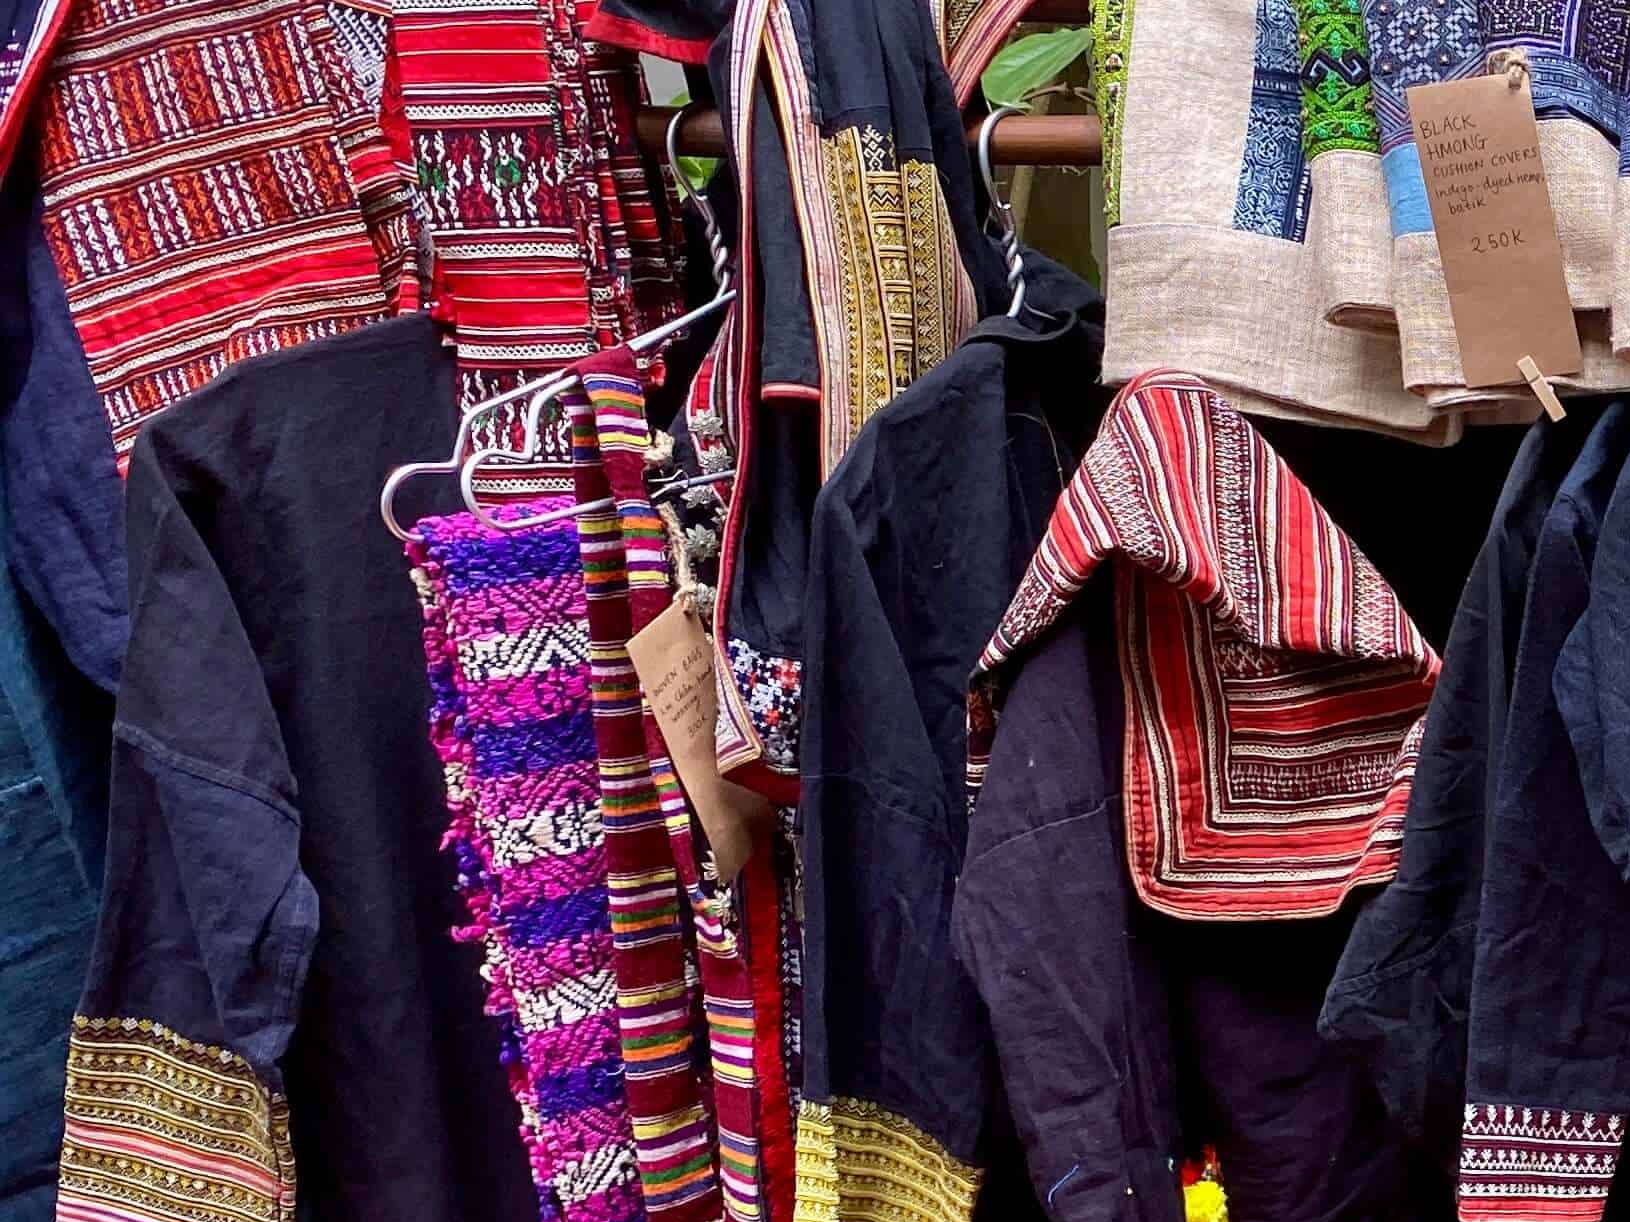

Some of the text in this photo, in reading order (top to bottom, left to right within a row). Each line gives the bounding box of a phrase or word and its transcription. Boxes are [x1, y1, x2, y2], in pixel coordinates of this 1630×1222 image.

[1419, 114, 1476, 139] BLACK
[1427, 133, 1488, 160] HMONG
[1433, 146, 1537, 178] CUSHION COVERS
[1448, 198, 1488, 216] batik
[1471, 227, 1525, 254] 250K
